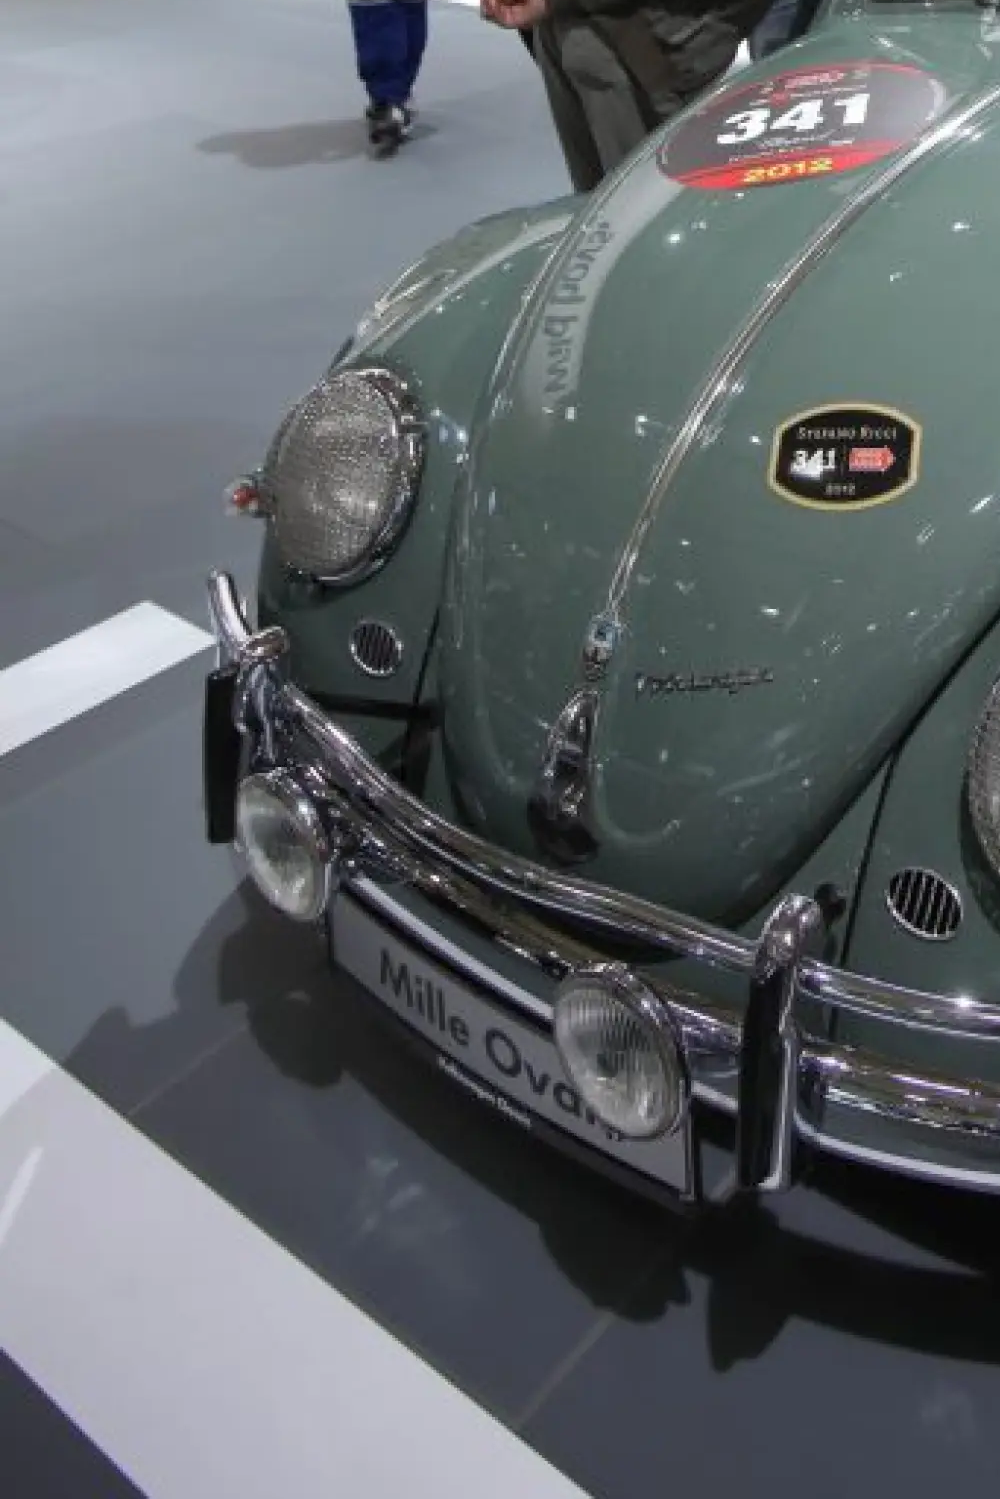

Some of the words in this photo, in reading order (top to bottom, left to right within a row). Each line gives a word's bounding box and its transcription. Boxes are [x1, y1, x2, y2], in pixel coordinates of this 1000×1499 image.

[716, 92, 870, 144] 341
[743, 156, 833, 183] 2012
[379, 947, 470, 1047] Mille
[485, 1027, 613, 1140] Ova
